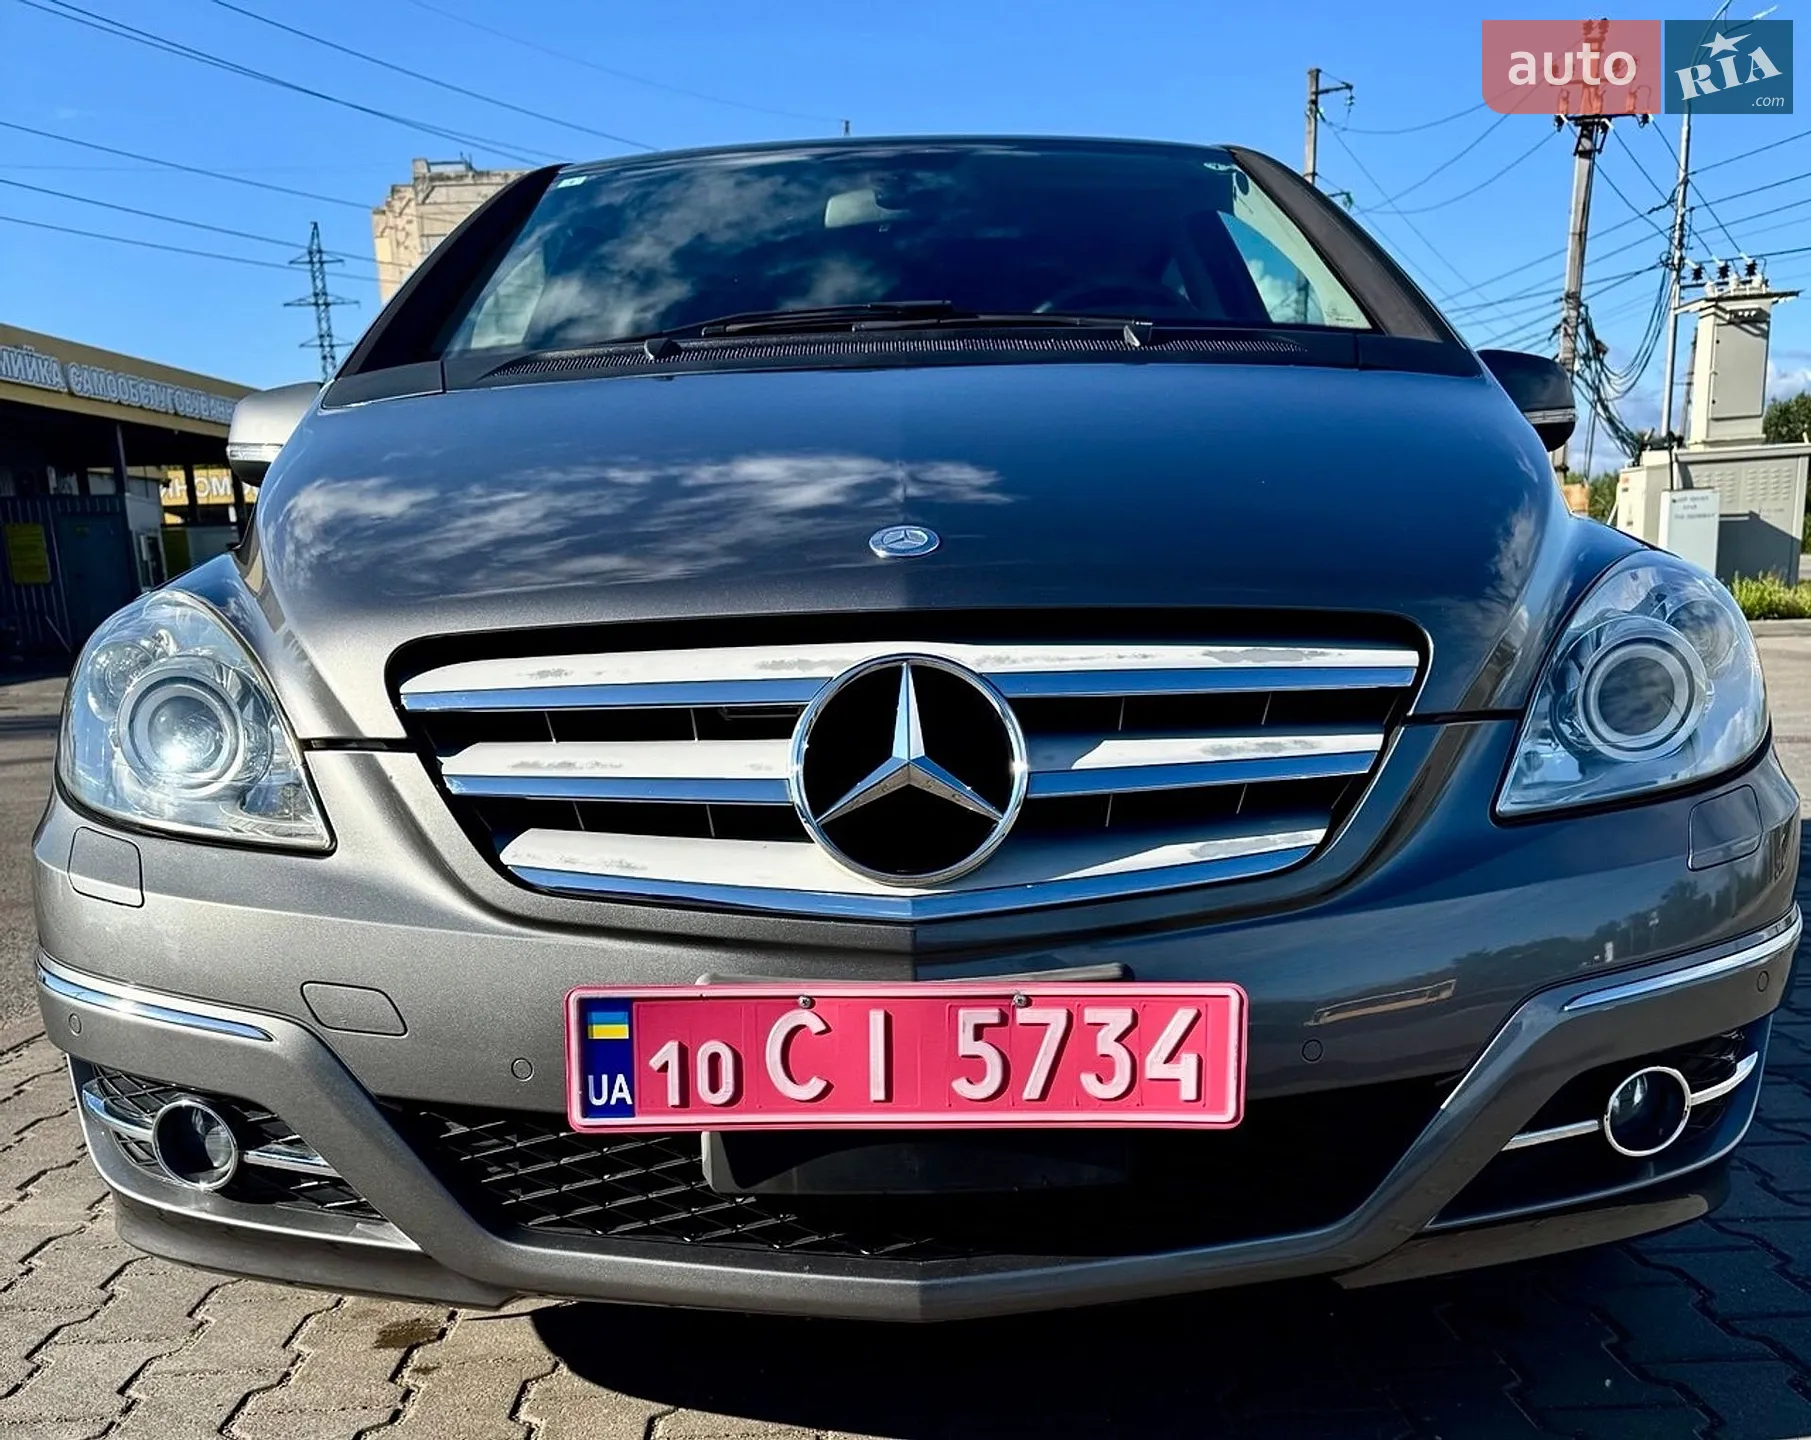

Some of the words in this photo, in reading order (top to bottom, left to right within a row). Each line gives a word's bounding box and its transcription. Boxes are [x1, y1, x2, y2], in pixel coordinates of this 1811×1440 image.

[588, 1074, 632, 1106] UA
[648, 1040, 735, 1108] 10
[951, 1008, 1201, 1102] 5734
